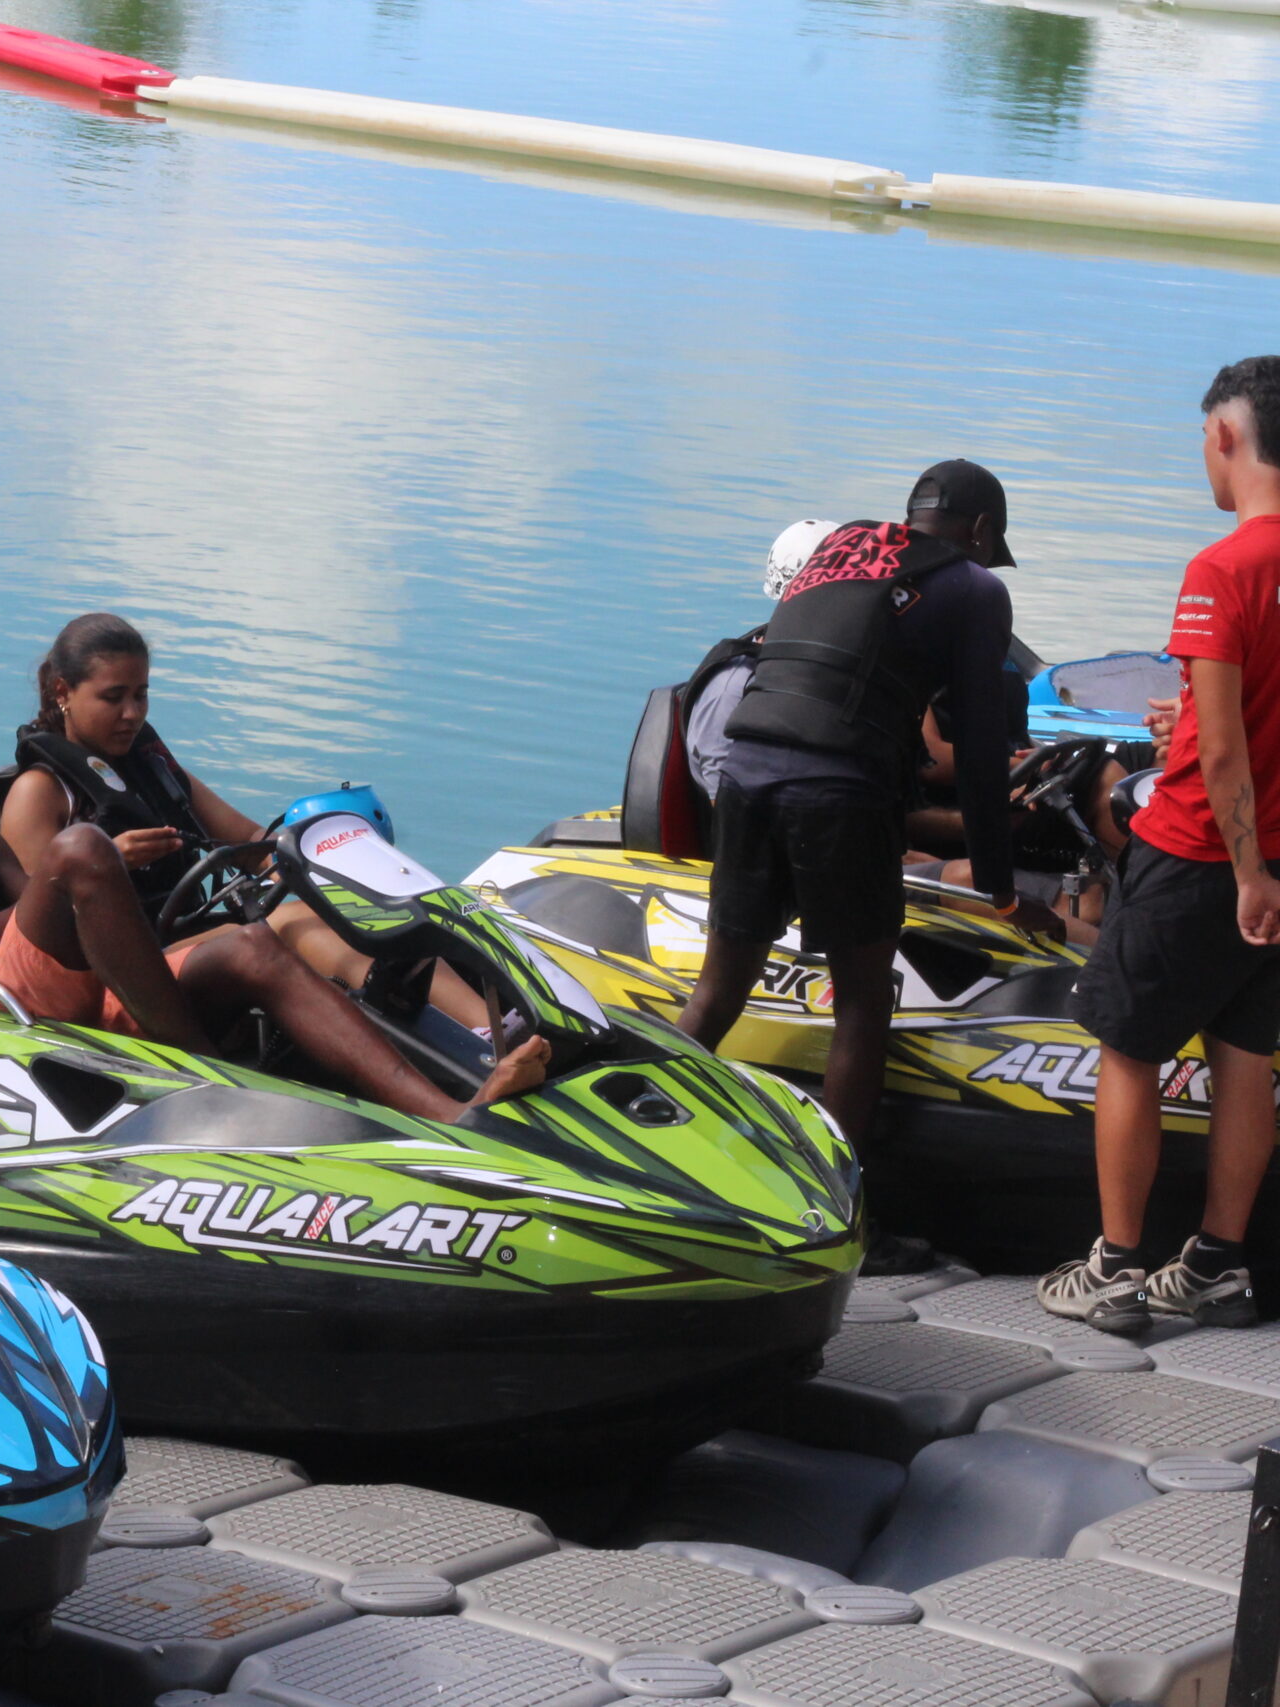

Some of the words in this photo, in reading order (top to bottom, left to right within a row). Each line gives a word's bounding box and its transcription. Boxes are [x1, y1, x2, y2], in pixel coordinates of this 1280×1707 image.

[1167, 1060, 1194, 1099] RACE
[110, 1178, 531, 1263] AQUAKART
[306, 1195, 337, 1240] RACE
